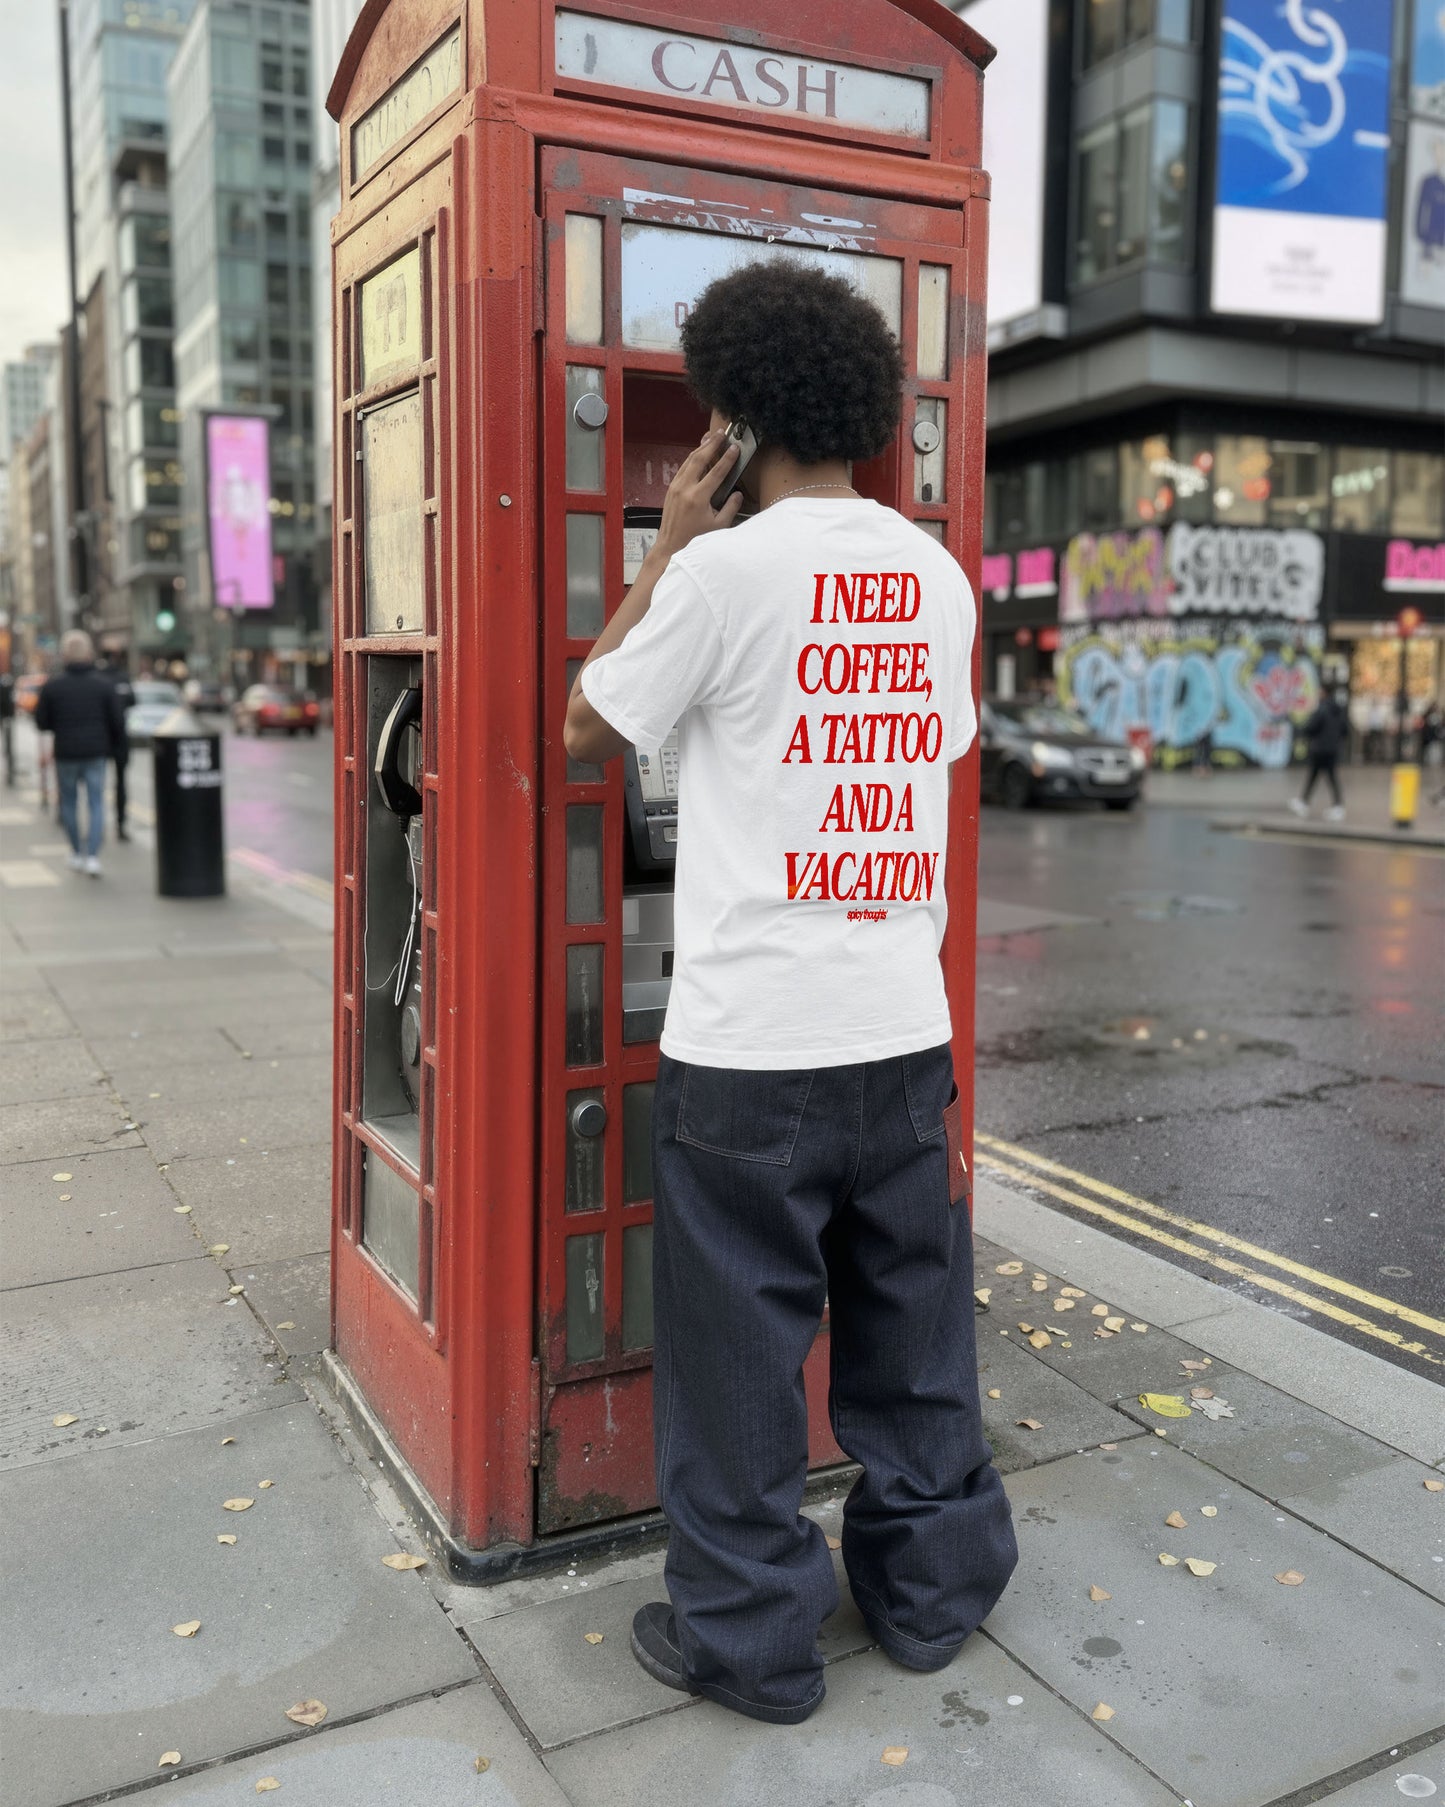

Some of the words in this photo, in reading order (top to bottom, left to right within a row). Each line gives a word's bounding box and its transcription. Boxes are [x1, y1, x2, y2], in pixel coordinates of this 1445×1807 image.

[651, 40, 838, 119] CASH
[809, 573, 829, 623] I
[829, 573, 921, 623] NEED
[797, 643, 932, 703] COFFEE,
[781, 714, 813, 763] A
[820, 712, 943, 763] TATTOO
[819, 784, 896, 832] AND
[894, 782, 914, 832] A
[784, 851, 939, 902] VACATION
[847, 909, 862, 922] spicy
